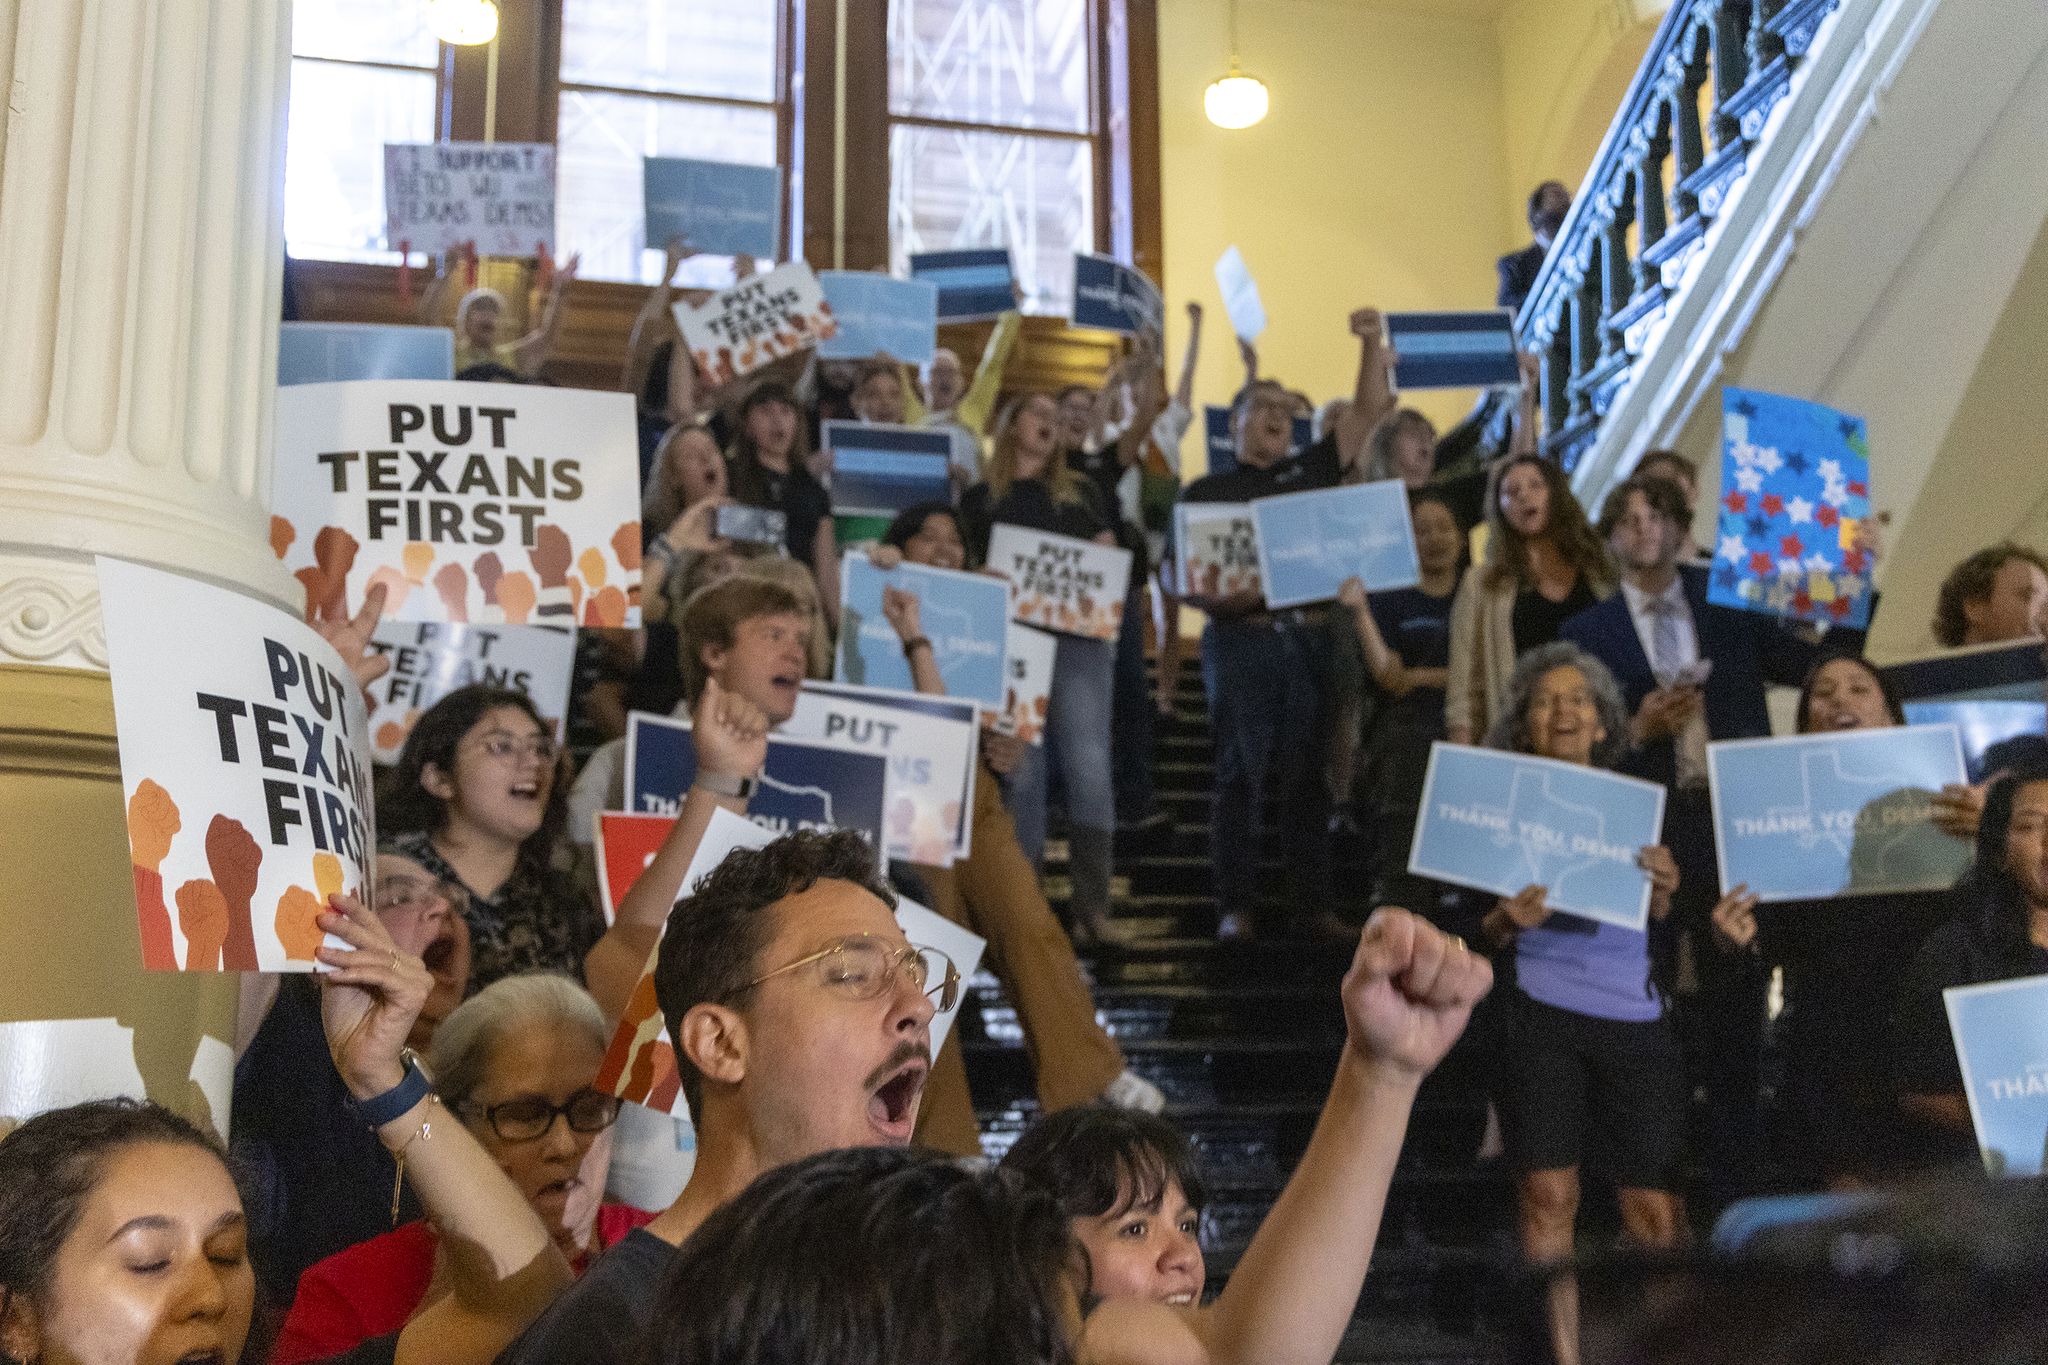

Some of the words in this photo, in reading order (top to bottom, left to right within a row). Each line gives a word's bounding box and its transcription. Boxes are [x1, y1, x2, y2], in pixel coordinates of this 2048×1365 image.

[436, 148, 534, 172] SUPPORT
[706, 287, 799, 335] TEXANS
[721, 281, 766, 310] PUT
[388, 403, 517, 448] PUT
[317, 450, 584, 501] TEXANS
[367, 499, 547, 547] FIRST
[1013, 553, 1104, 589] TEXANS
[1039, 541, 1083, 564] PUT
[263, 637, 348, 738] PUT
[824, 712, 900, 747] PUT
[1438, 802, 1511, 832] THANK
[1518, 820, 1565, 848] YOU
[1734, 811, 1812, 836] THANK
